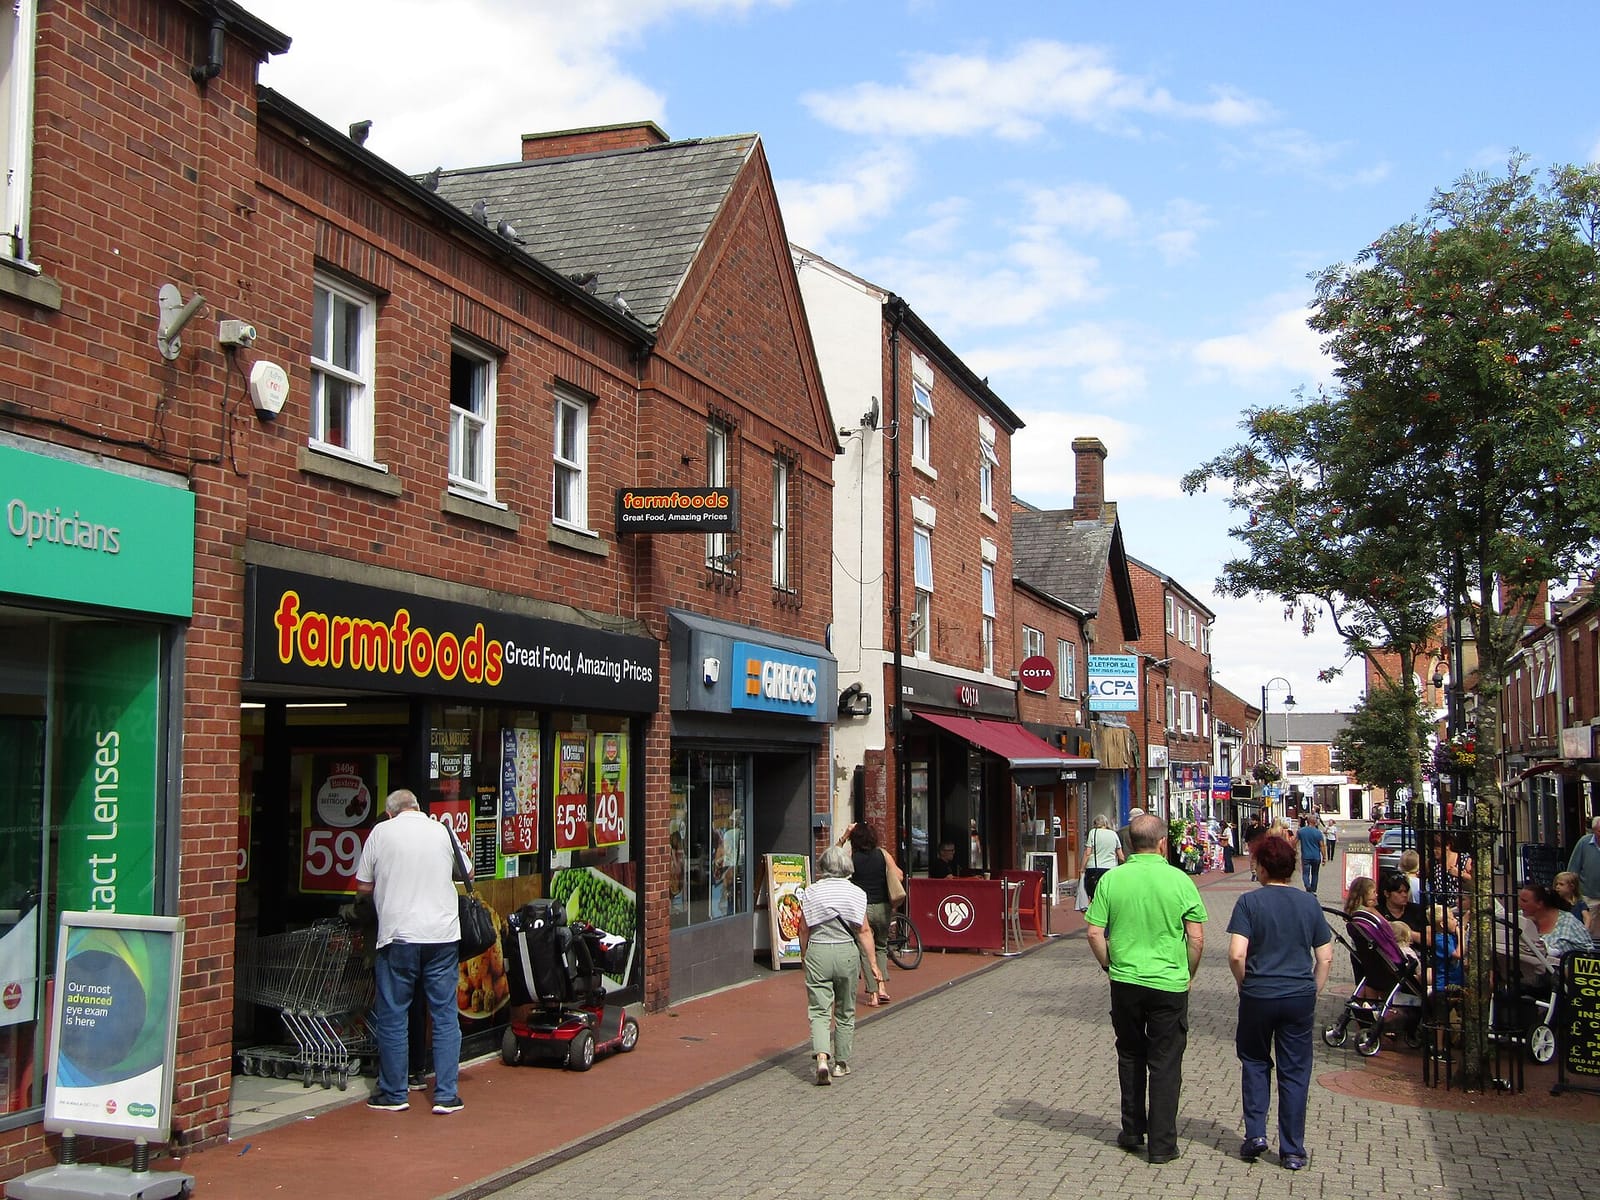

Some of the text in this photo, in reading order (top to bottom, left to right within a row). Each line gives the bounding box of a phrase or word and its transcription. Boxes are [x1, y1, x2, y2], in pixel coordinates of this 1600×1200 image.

[623, 491, 729, 509] farmfoods
[7, 498, 121, 554] Opticians
[645, 513, 667, 522] Food,
[668, 513, 701, 522] Amazing
[703, 512, 728, 521] Prices
[274, 590, 503, 686] farmfoods
[504, 640, 653, 684] Great Food, Amazing Prices
[762, 660, 817, 704] GREGGS
[1022, 669, 1052, 678] COSTA
[961, 685, 980, 707] COSTA
[1100, 680, 1136, 696] CPA
[335, 763, 355, 774] 340g
[87, 730, 120, 841] Lenses
[518, 815, 534, 828] 2 for
[557, 804, 587, 841] £5.99
[596, 794, 624, 841] 49p
[519, 828, 532, 850] £3
[306, 830, 362, 877] 59
[68, 981, 111, 995] Our most
[67, 993, 113, 1006] advanced
[66, 1005, 109, 1017] eye exam
[65, 1014, 96, 1027] is here
[1568, 1057, 1586, 1065] GOLD
